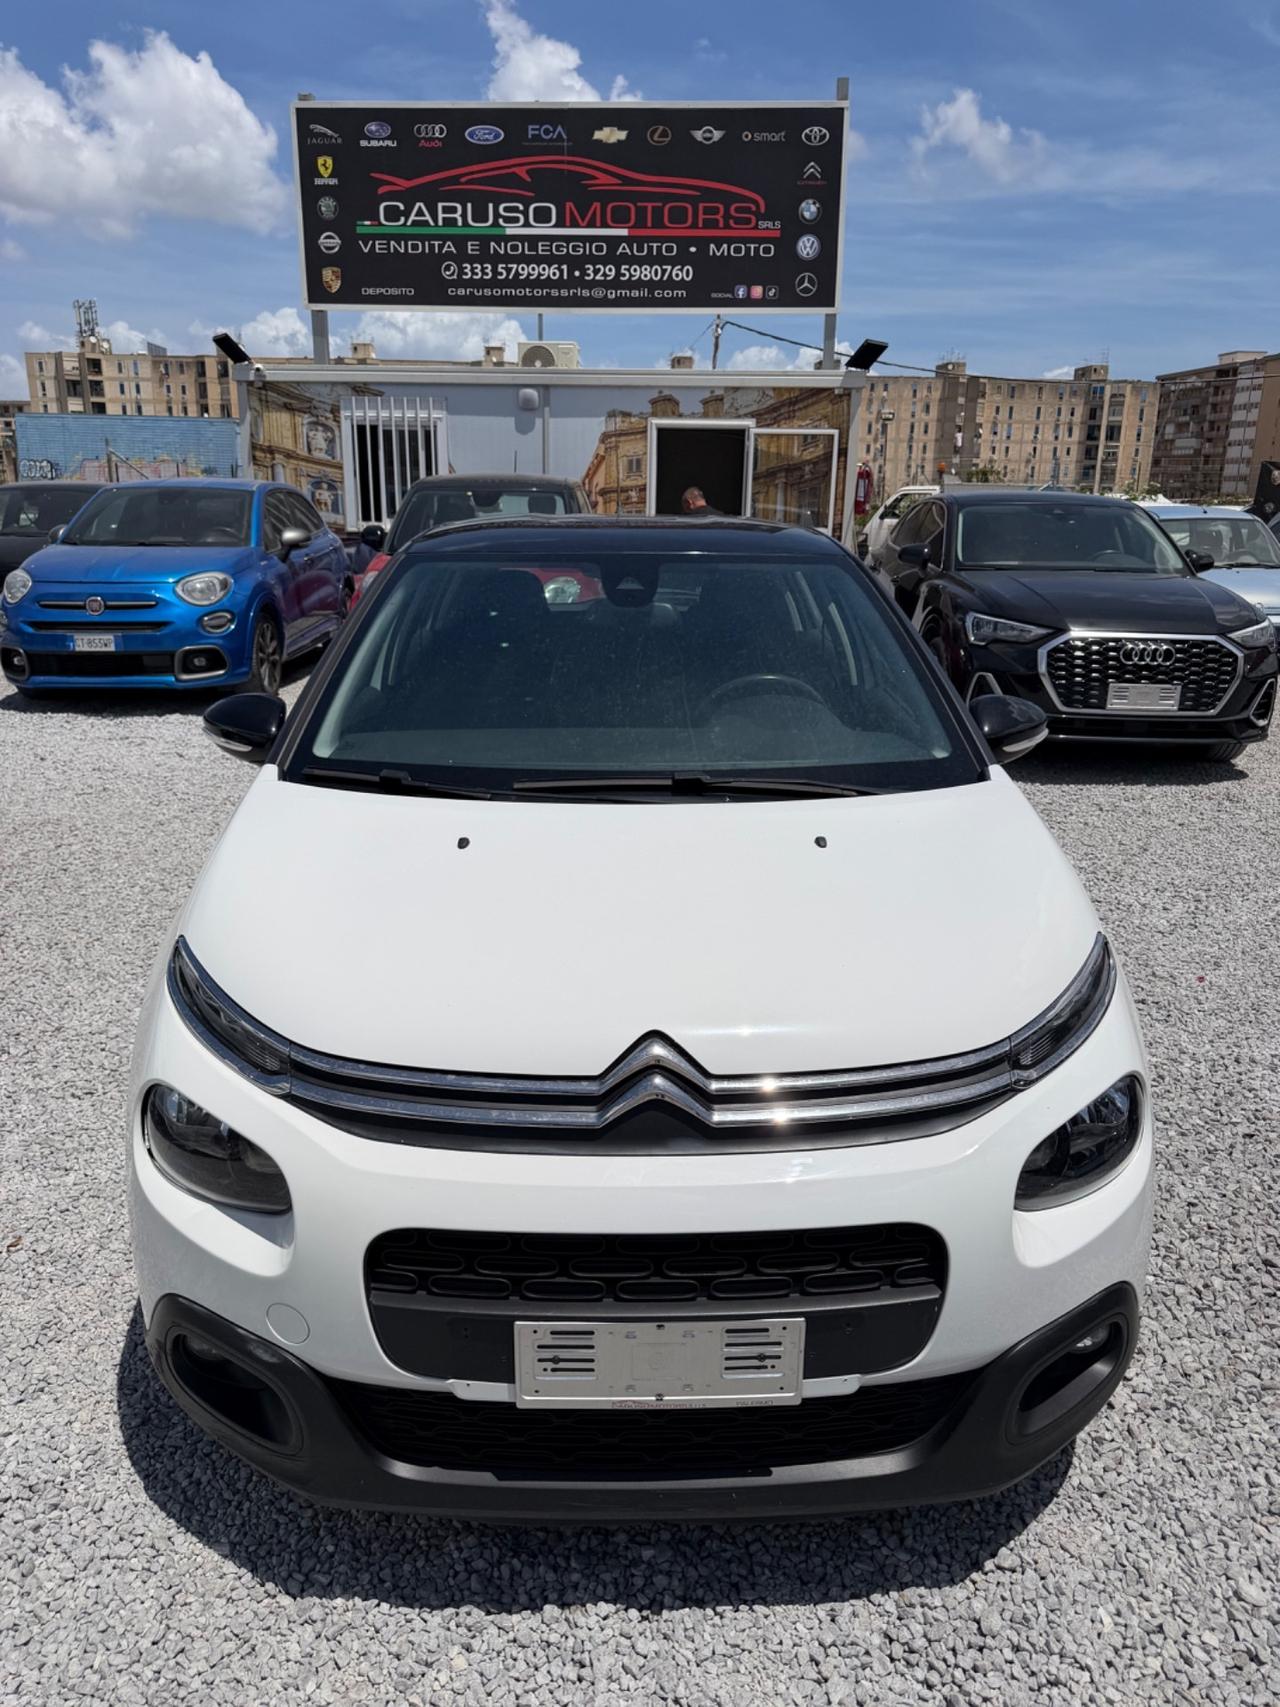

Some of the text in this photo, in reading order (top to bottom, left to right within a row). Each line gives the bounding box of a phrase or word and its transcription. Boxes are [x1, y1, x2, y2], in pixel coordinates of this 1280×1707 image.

[527, 124, 567, 139] FCA
[753, 130, 786, 142] smart
[307, 136, 342, 145] JAGUAR
[359, 139, 397, 147] SUBARU
[418, 139, 443, 147] Audi
[378, 201, 781, 229] CARUSO MOTORS SRLS
[358, 240, 775, 257] VENDITA E NOLEGGIO AUTO MOTO
[461, 263, 694, 281] 333 5799961 329 5980760
[361, 287, 415, 296] DEPOSITO
[447, 286, 687, 299] carusomotorssrls@gmail.com
